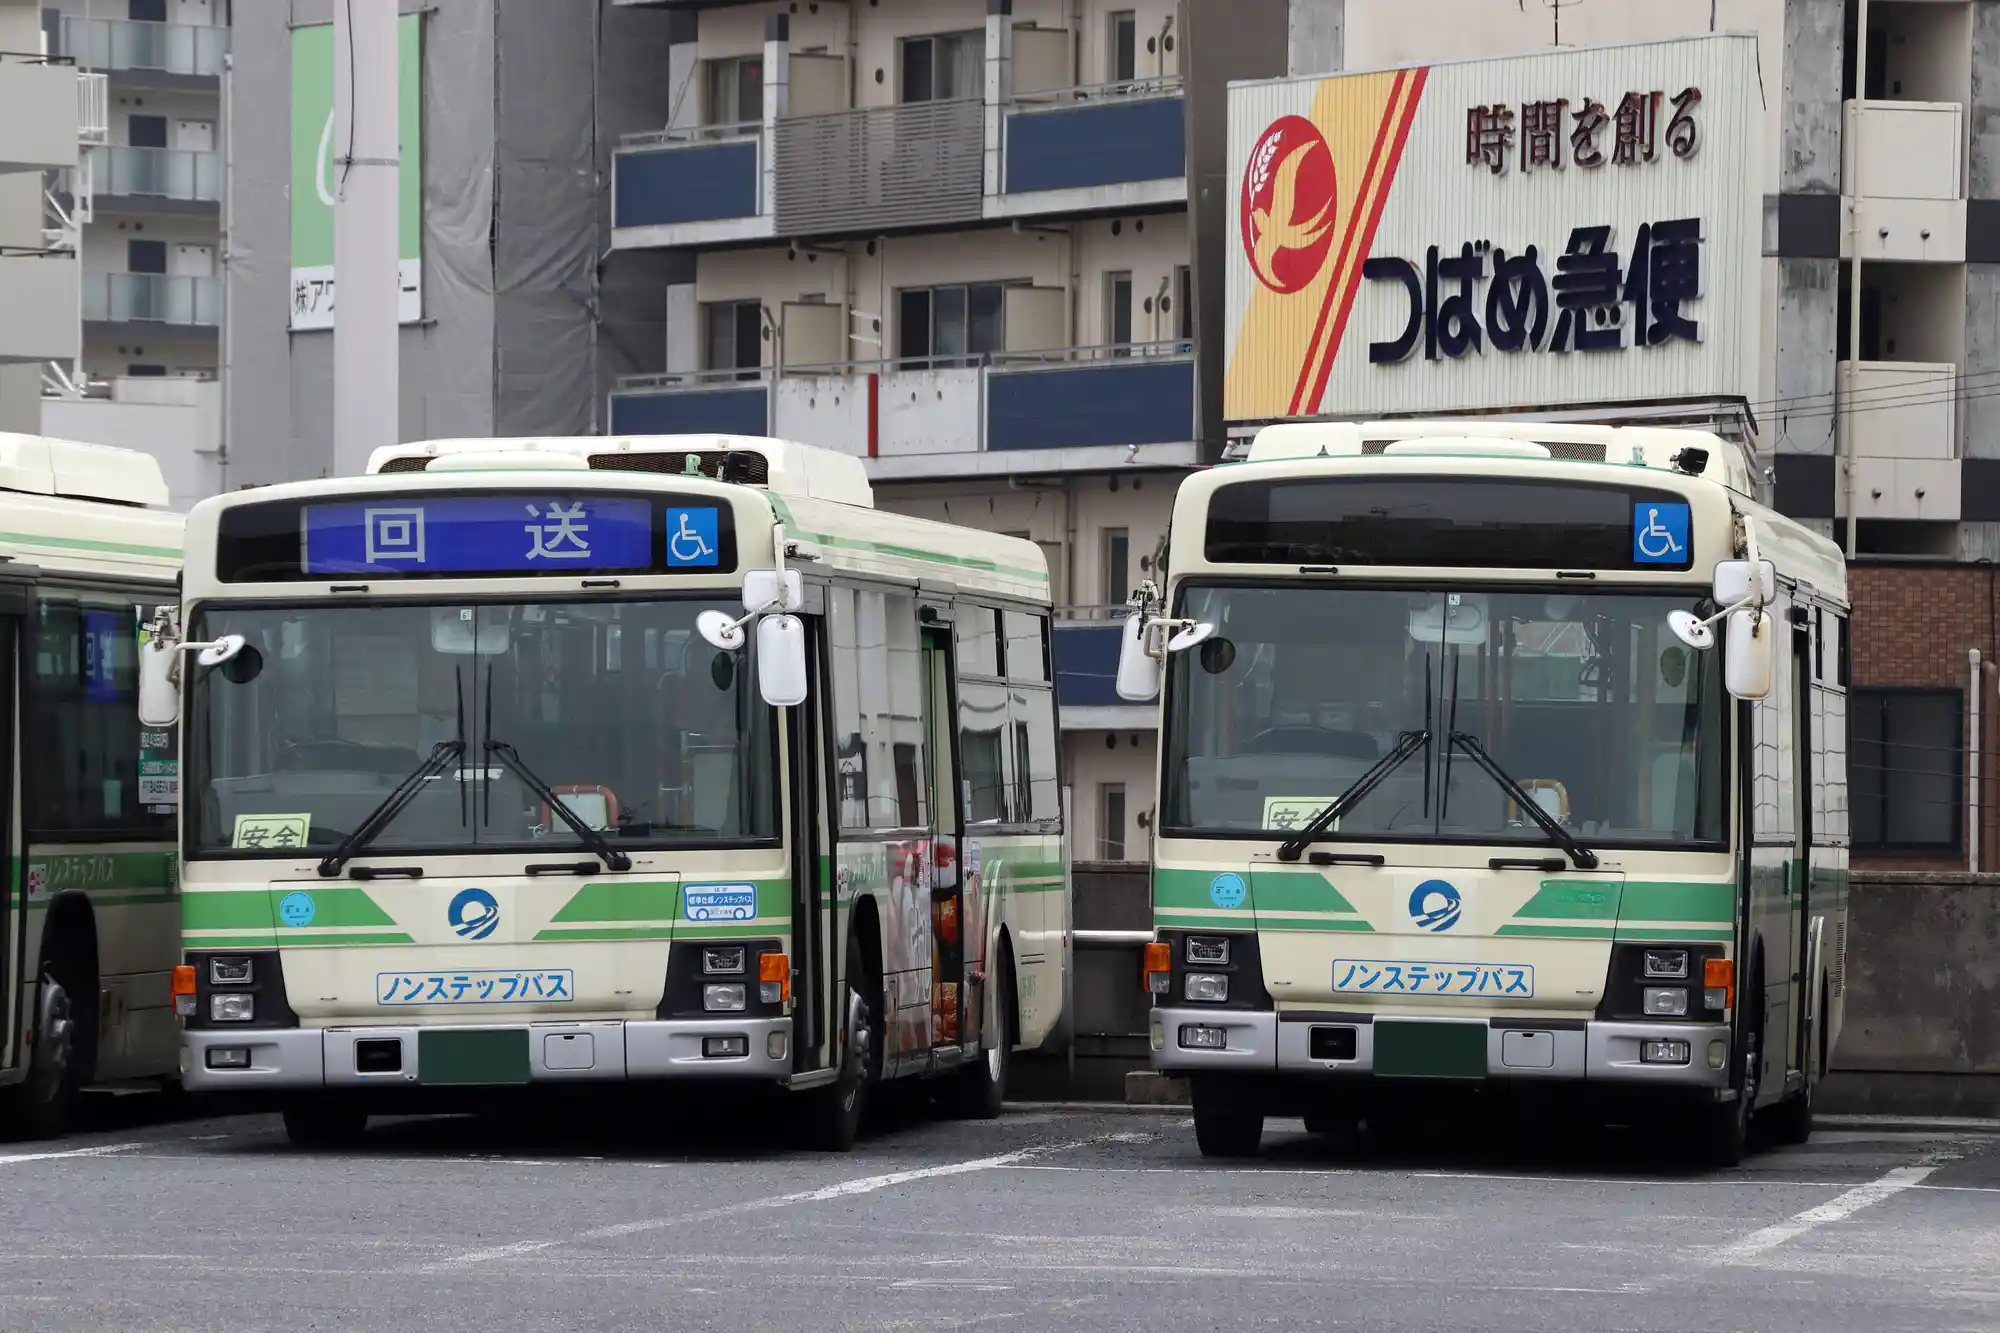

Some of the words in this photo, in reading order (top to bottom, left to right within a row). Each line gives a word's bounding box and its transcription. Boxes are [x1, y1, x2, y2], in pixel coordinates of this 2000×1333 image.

[1465, 87, 1702, 175] 時間を創る
[1363, 217, 1705, 364] つばめ急便
[364, 501, 592, 564] 回送
[241, 824, 301, 849] 安全
[381, 973, 570, 1002] ノンステップバス
[1336, 963, 1529, 996] ノンステップバス
